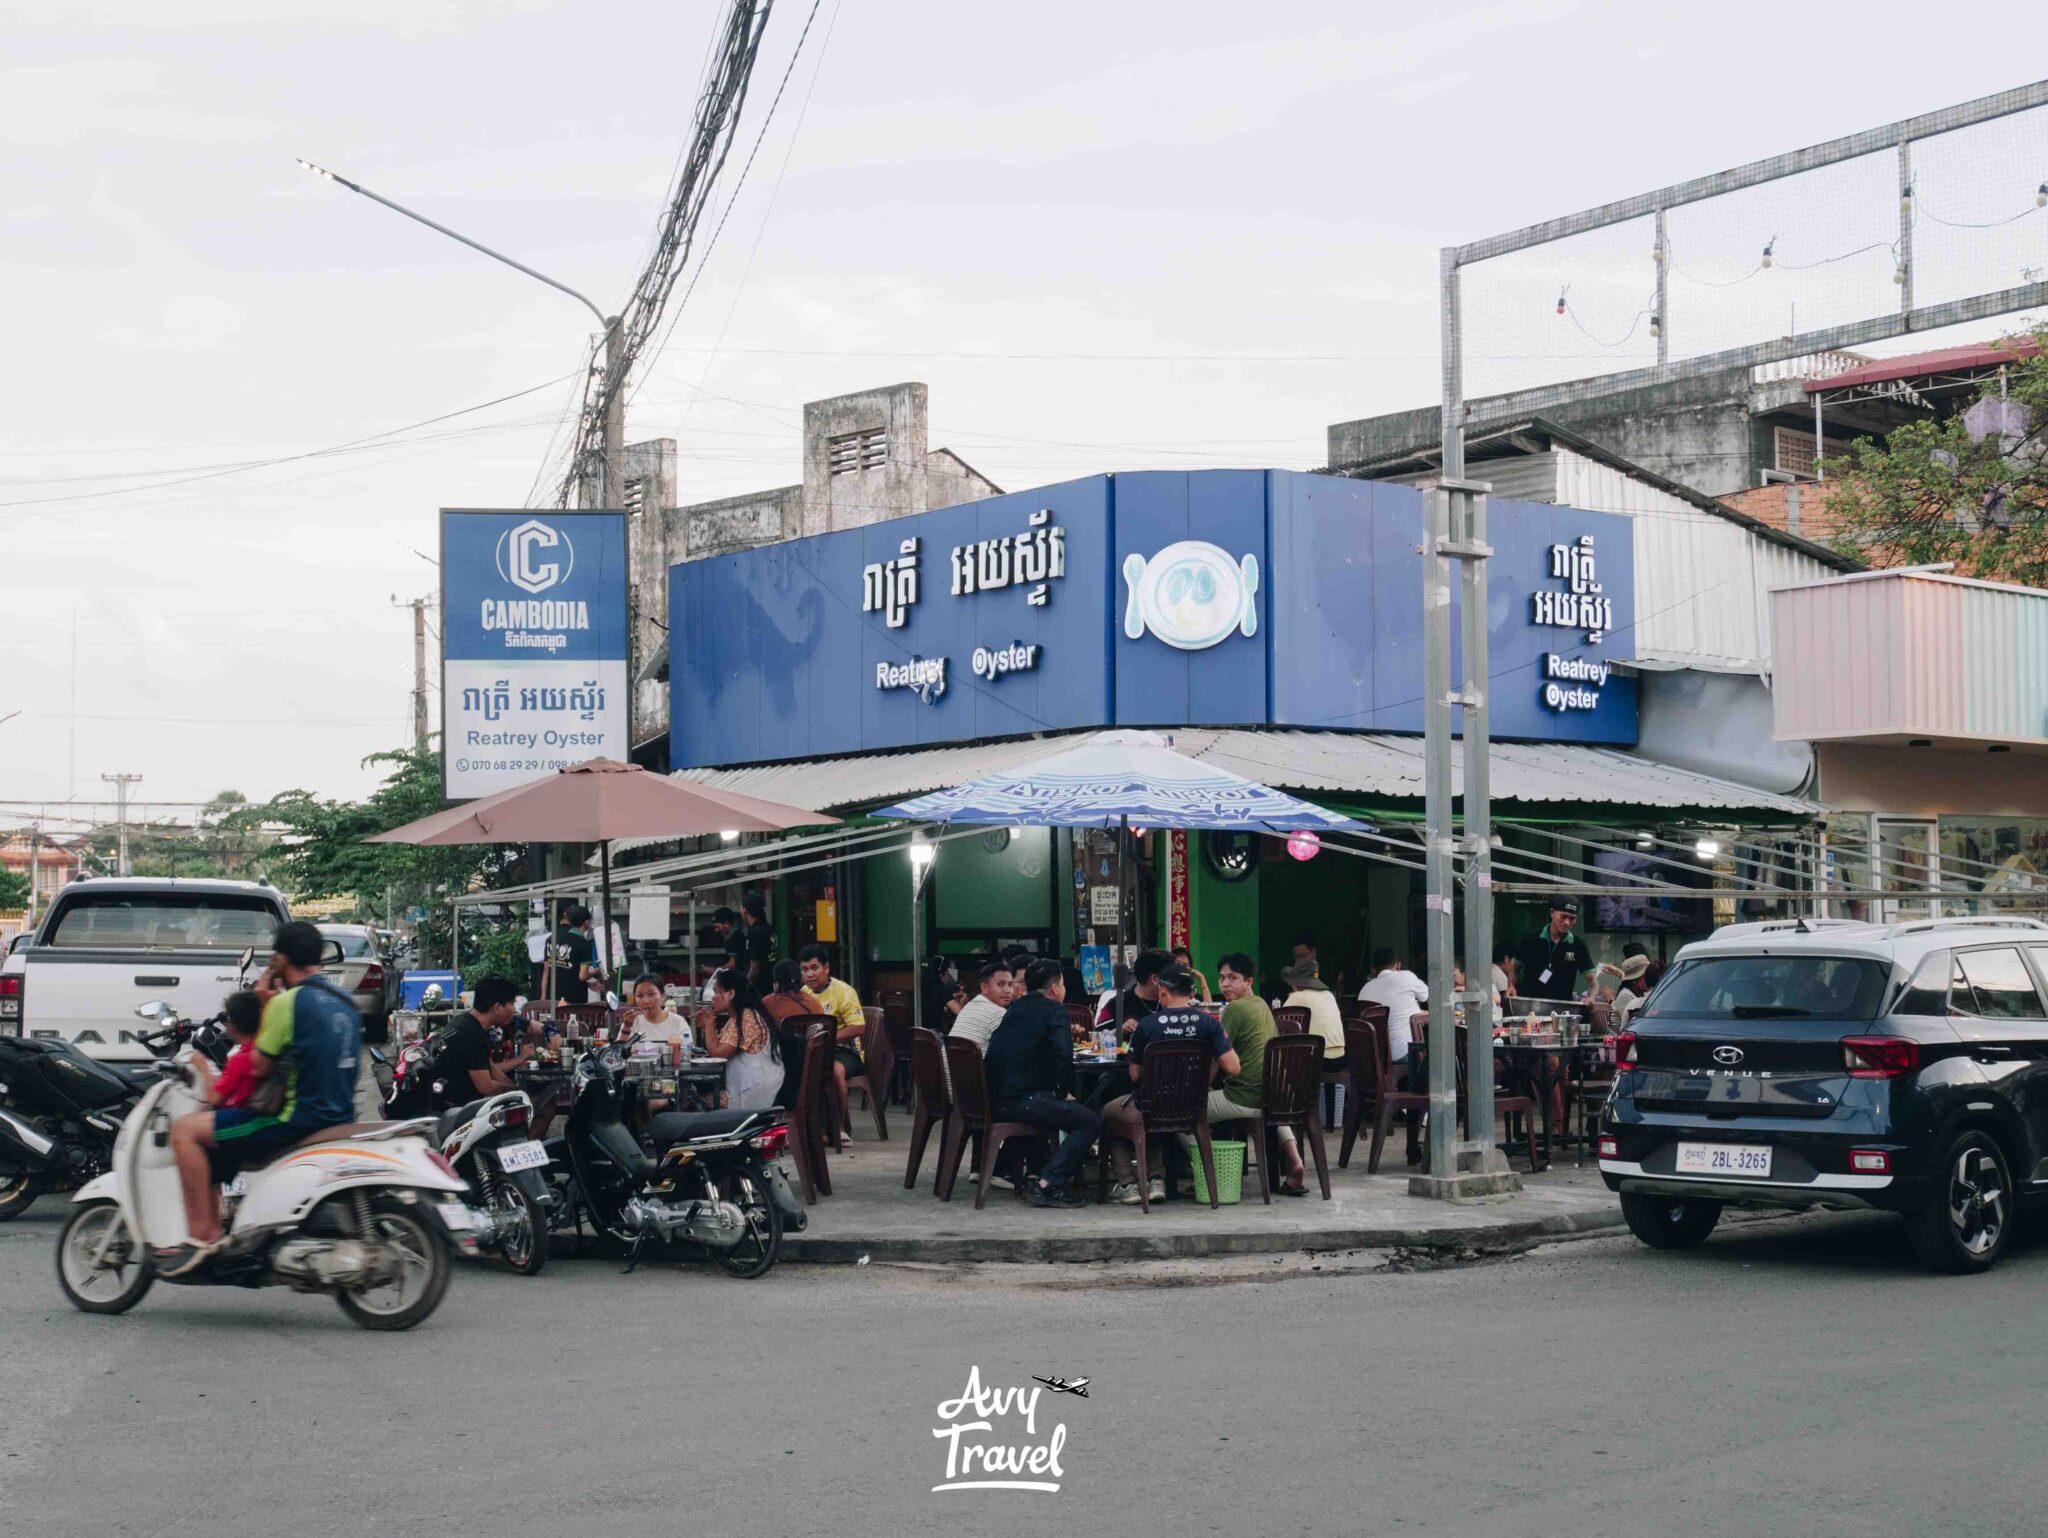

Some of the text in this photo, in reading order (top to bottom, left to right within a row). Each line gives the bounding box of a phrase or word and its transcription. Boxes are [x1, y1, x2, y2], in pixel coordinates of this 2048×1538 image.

[481, 598, 589, 631] CAMBODIA
[972, 643, 1036, 681] Oyster
[1549, 654, 1608, 686] Reatrey
[462, 680, 510, 721] រាត្រី
[1546, 684, 1599, 711] Oyster
[467, 730, 605, 749] Reatrey Oyster
[472, 760, 491, 770] 070
[493, 760, 506, 770] 68
[509, 760, 522, 770] 29
[525, 760, 538, 770] 29
[1005, 782, 1130, 801] Angkor
[1164, 1026, 1183, 1035] Jeep
[1689, 1069, 1772, 1078] VENUE
[1711, 1150, 1767, 1169] 2BL-3265
